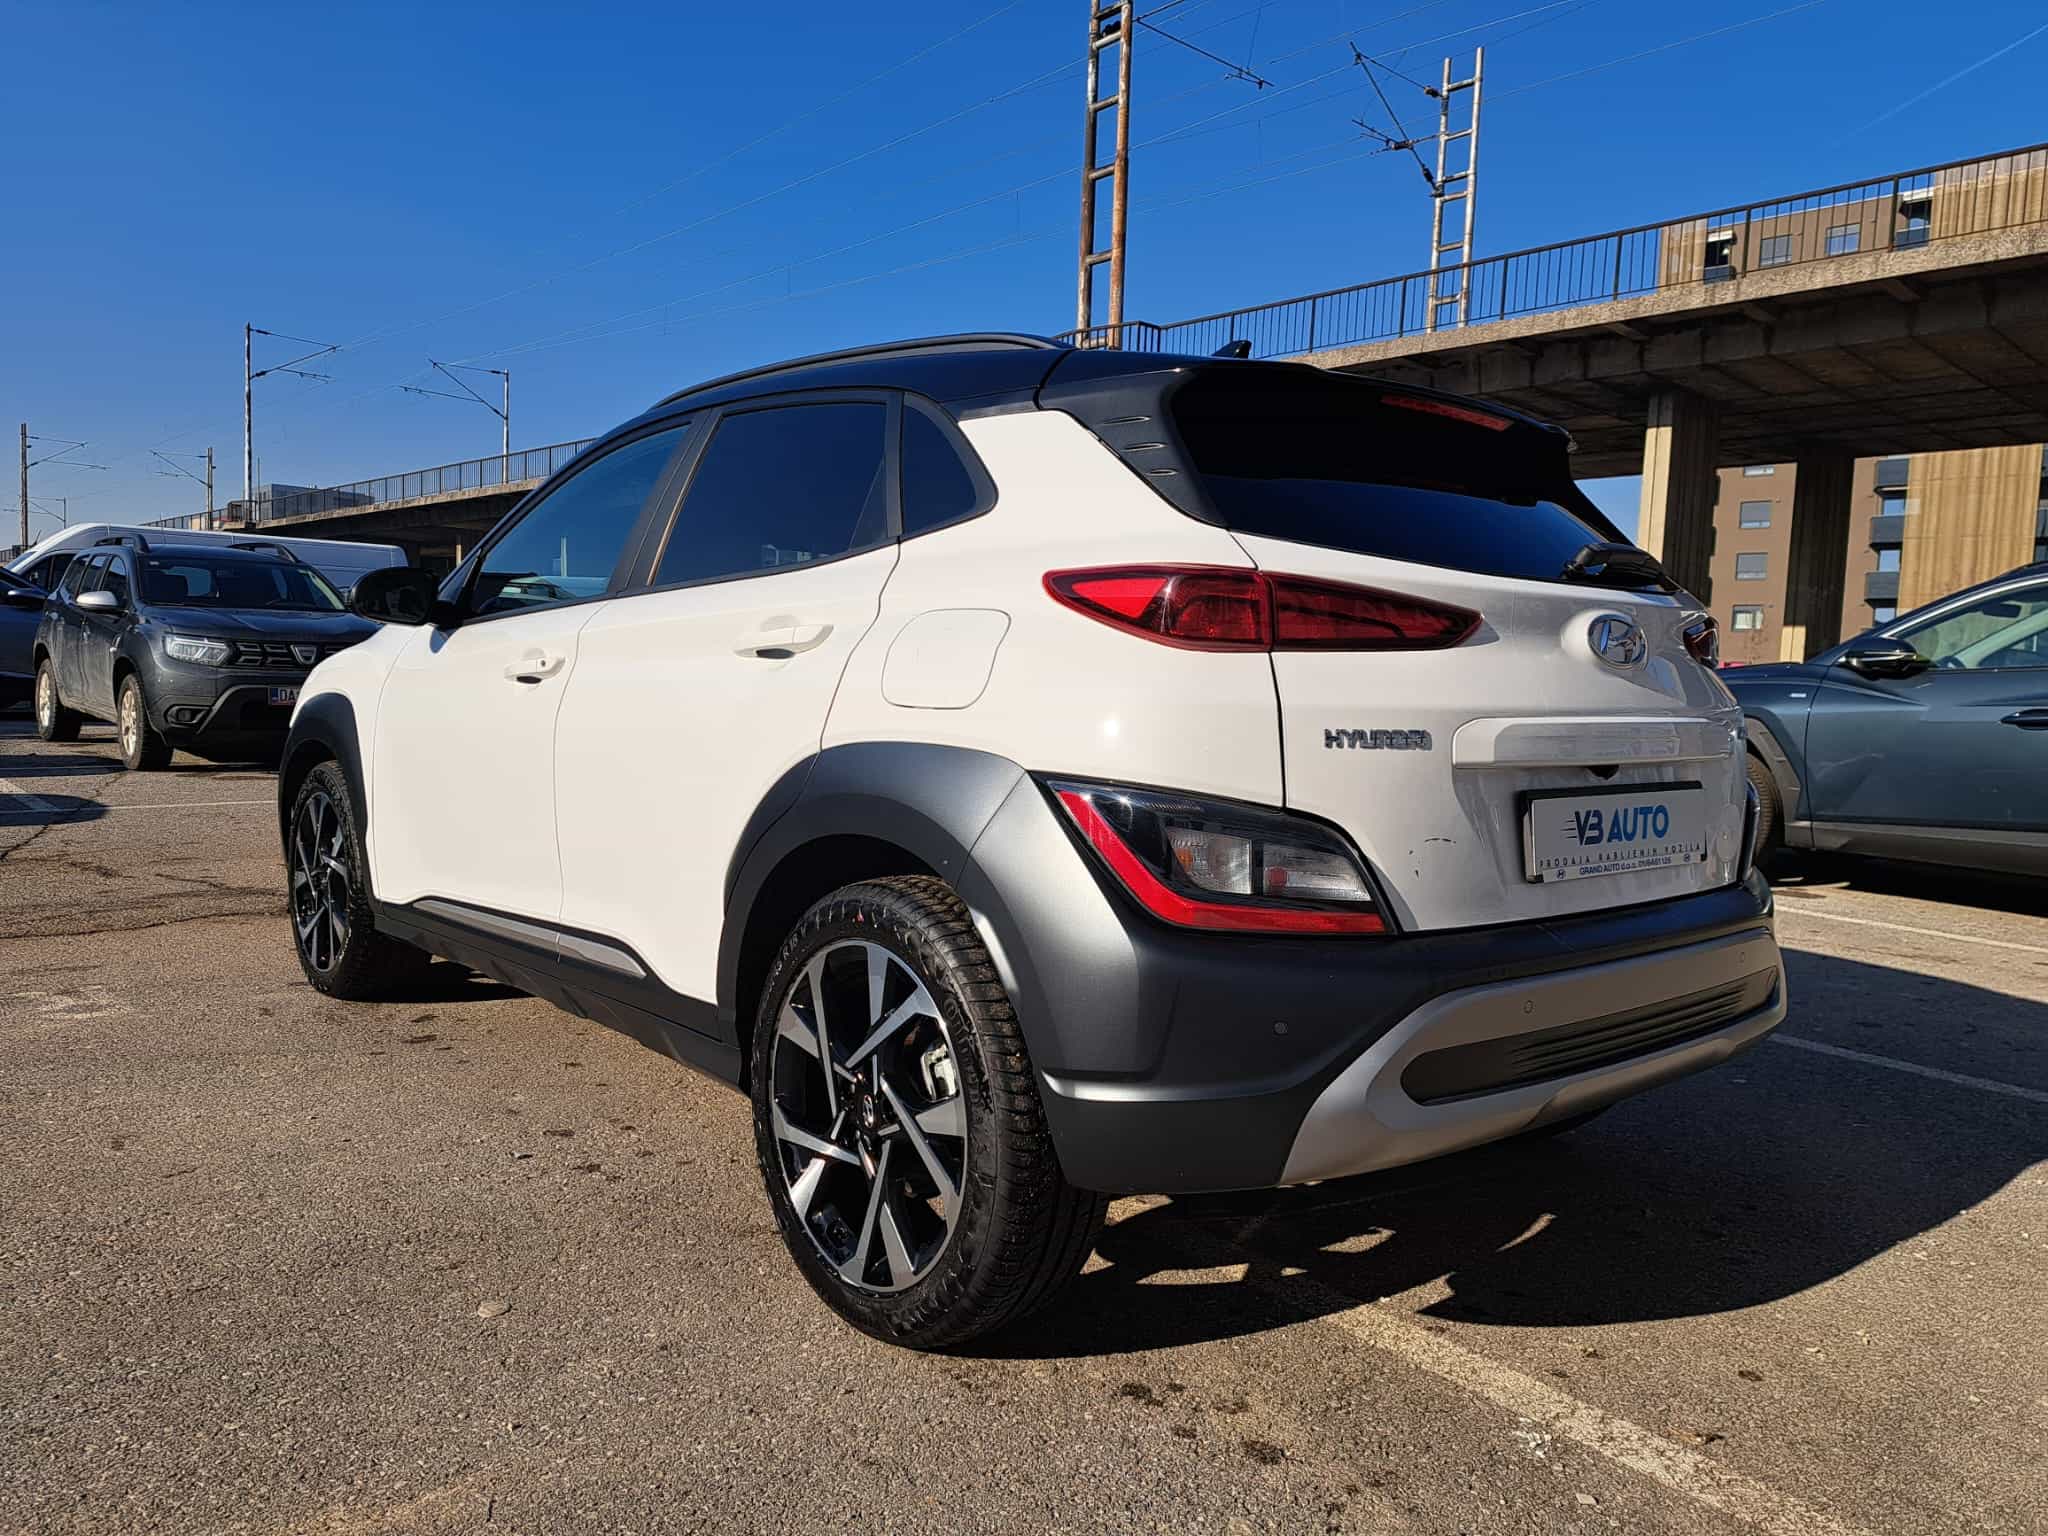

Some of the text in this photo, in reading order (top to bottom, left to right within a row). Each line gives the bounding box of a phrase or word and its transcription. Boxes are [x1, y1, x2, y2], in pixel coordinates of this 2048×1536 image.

[1607, 804, 1669, 843] AUTO
[1579, 863, 1603, 875] GRAND
[1603, 861, 1620, 873] AUTO
